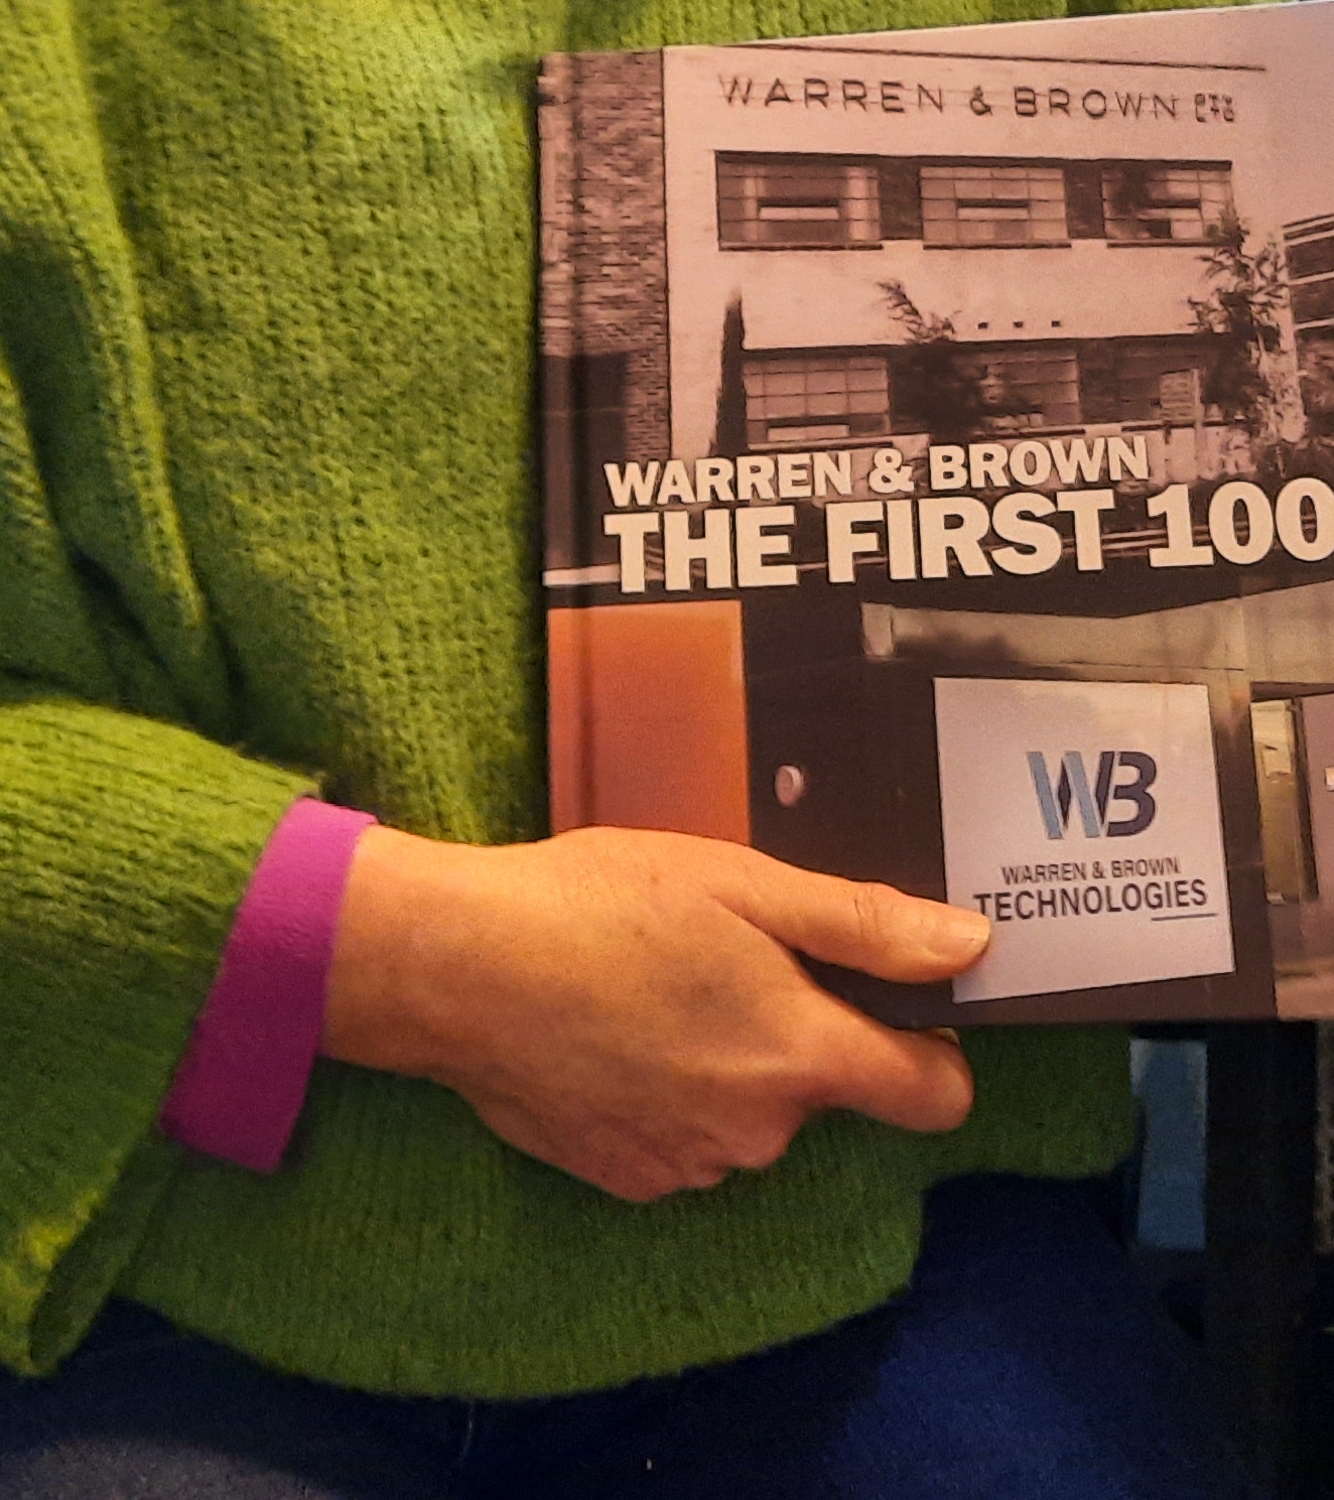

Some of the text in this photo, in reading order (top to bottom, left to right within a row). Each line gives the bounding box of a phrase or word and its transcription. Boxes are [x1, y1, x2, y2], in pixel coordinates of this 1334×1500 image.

[717, 73, 946, 116] WARREN
[968, 85, 995, 117] &
[1013, 84, 1178, 122] BROWN
[603, 435, 1151, 508] WARREN & BROWN
[603, 504, 799, 594] THE
[825, 488, 1116, 585] FIRST
[1026, 750, 1158, 841] WB
[972, 879, 1209, 922] TECHNOLOGIES
[1001, 856, 1181, 886] WARREN & BROWN
